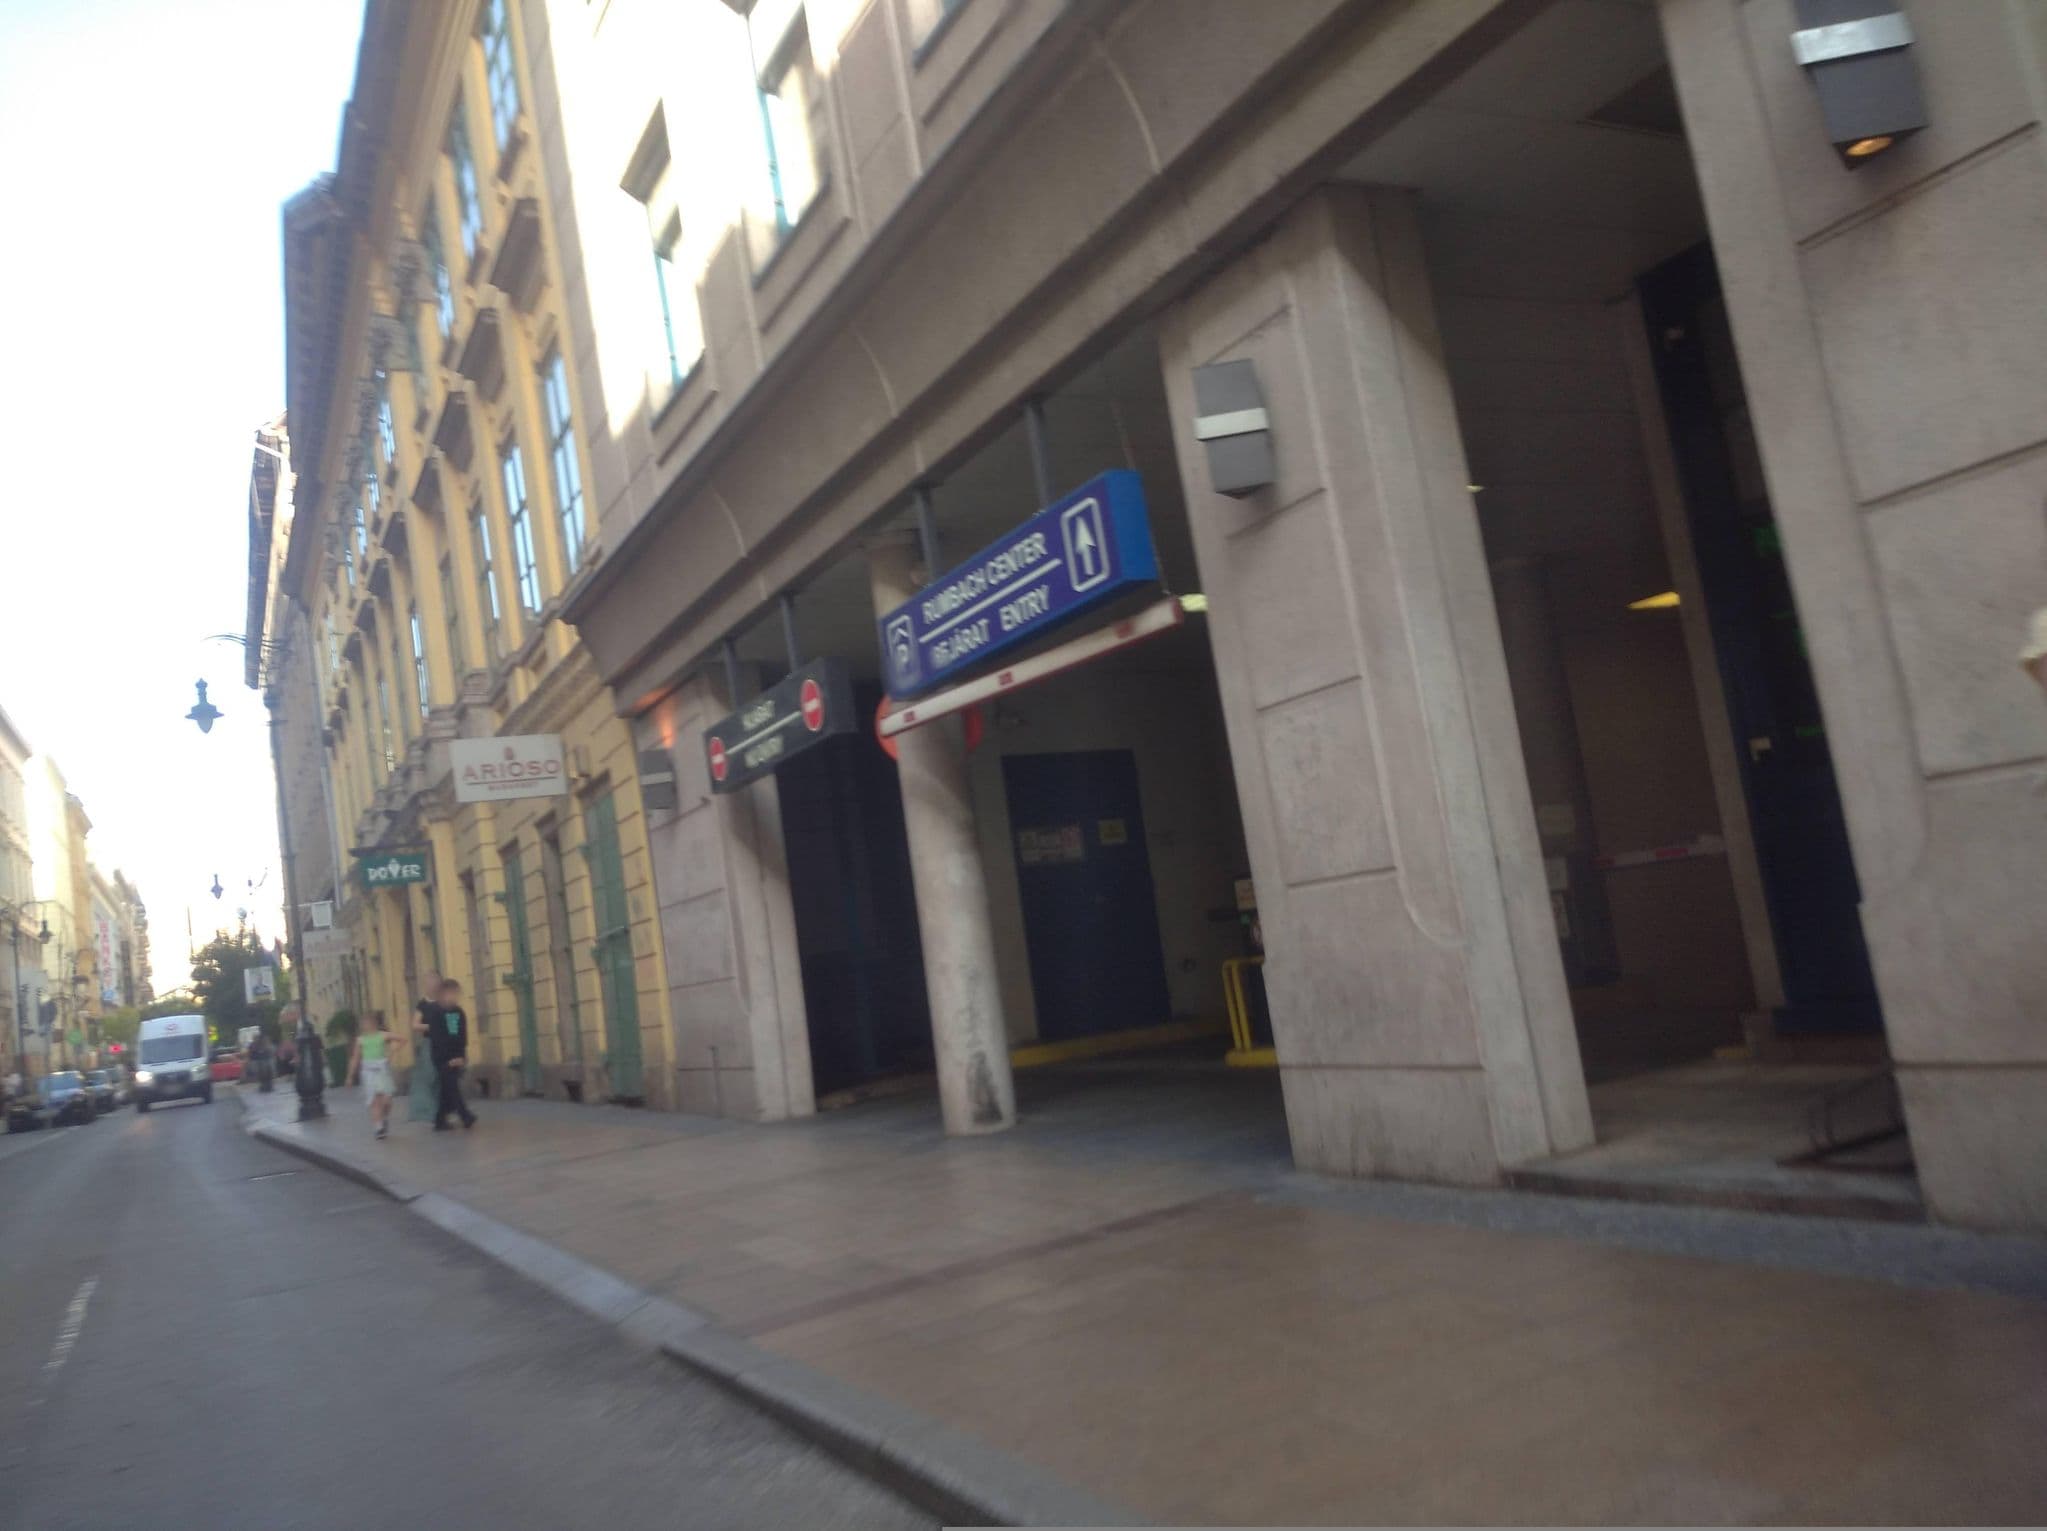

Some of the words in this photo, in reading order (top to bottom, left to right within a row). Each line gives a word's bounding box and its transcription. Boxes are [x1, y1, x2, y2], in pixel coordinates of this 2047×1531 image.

[922, 568, 988, 625] RUMBACH
[986, 532, 1048, 585] CENTER
[999, 585, 1050, 631] ENTRY
[463, 760, 561, 781] ARIOSO
